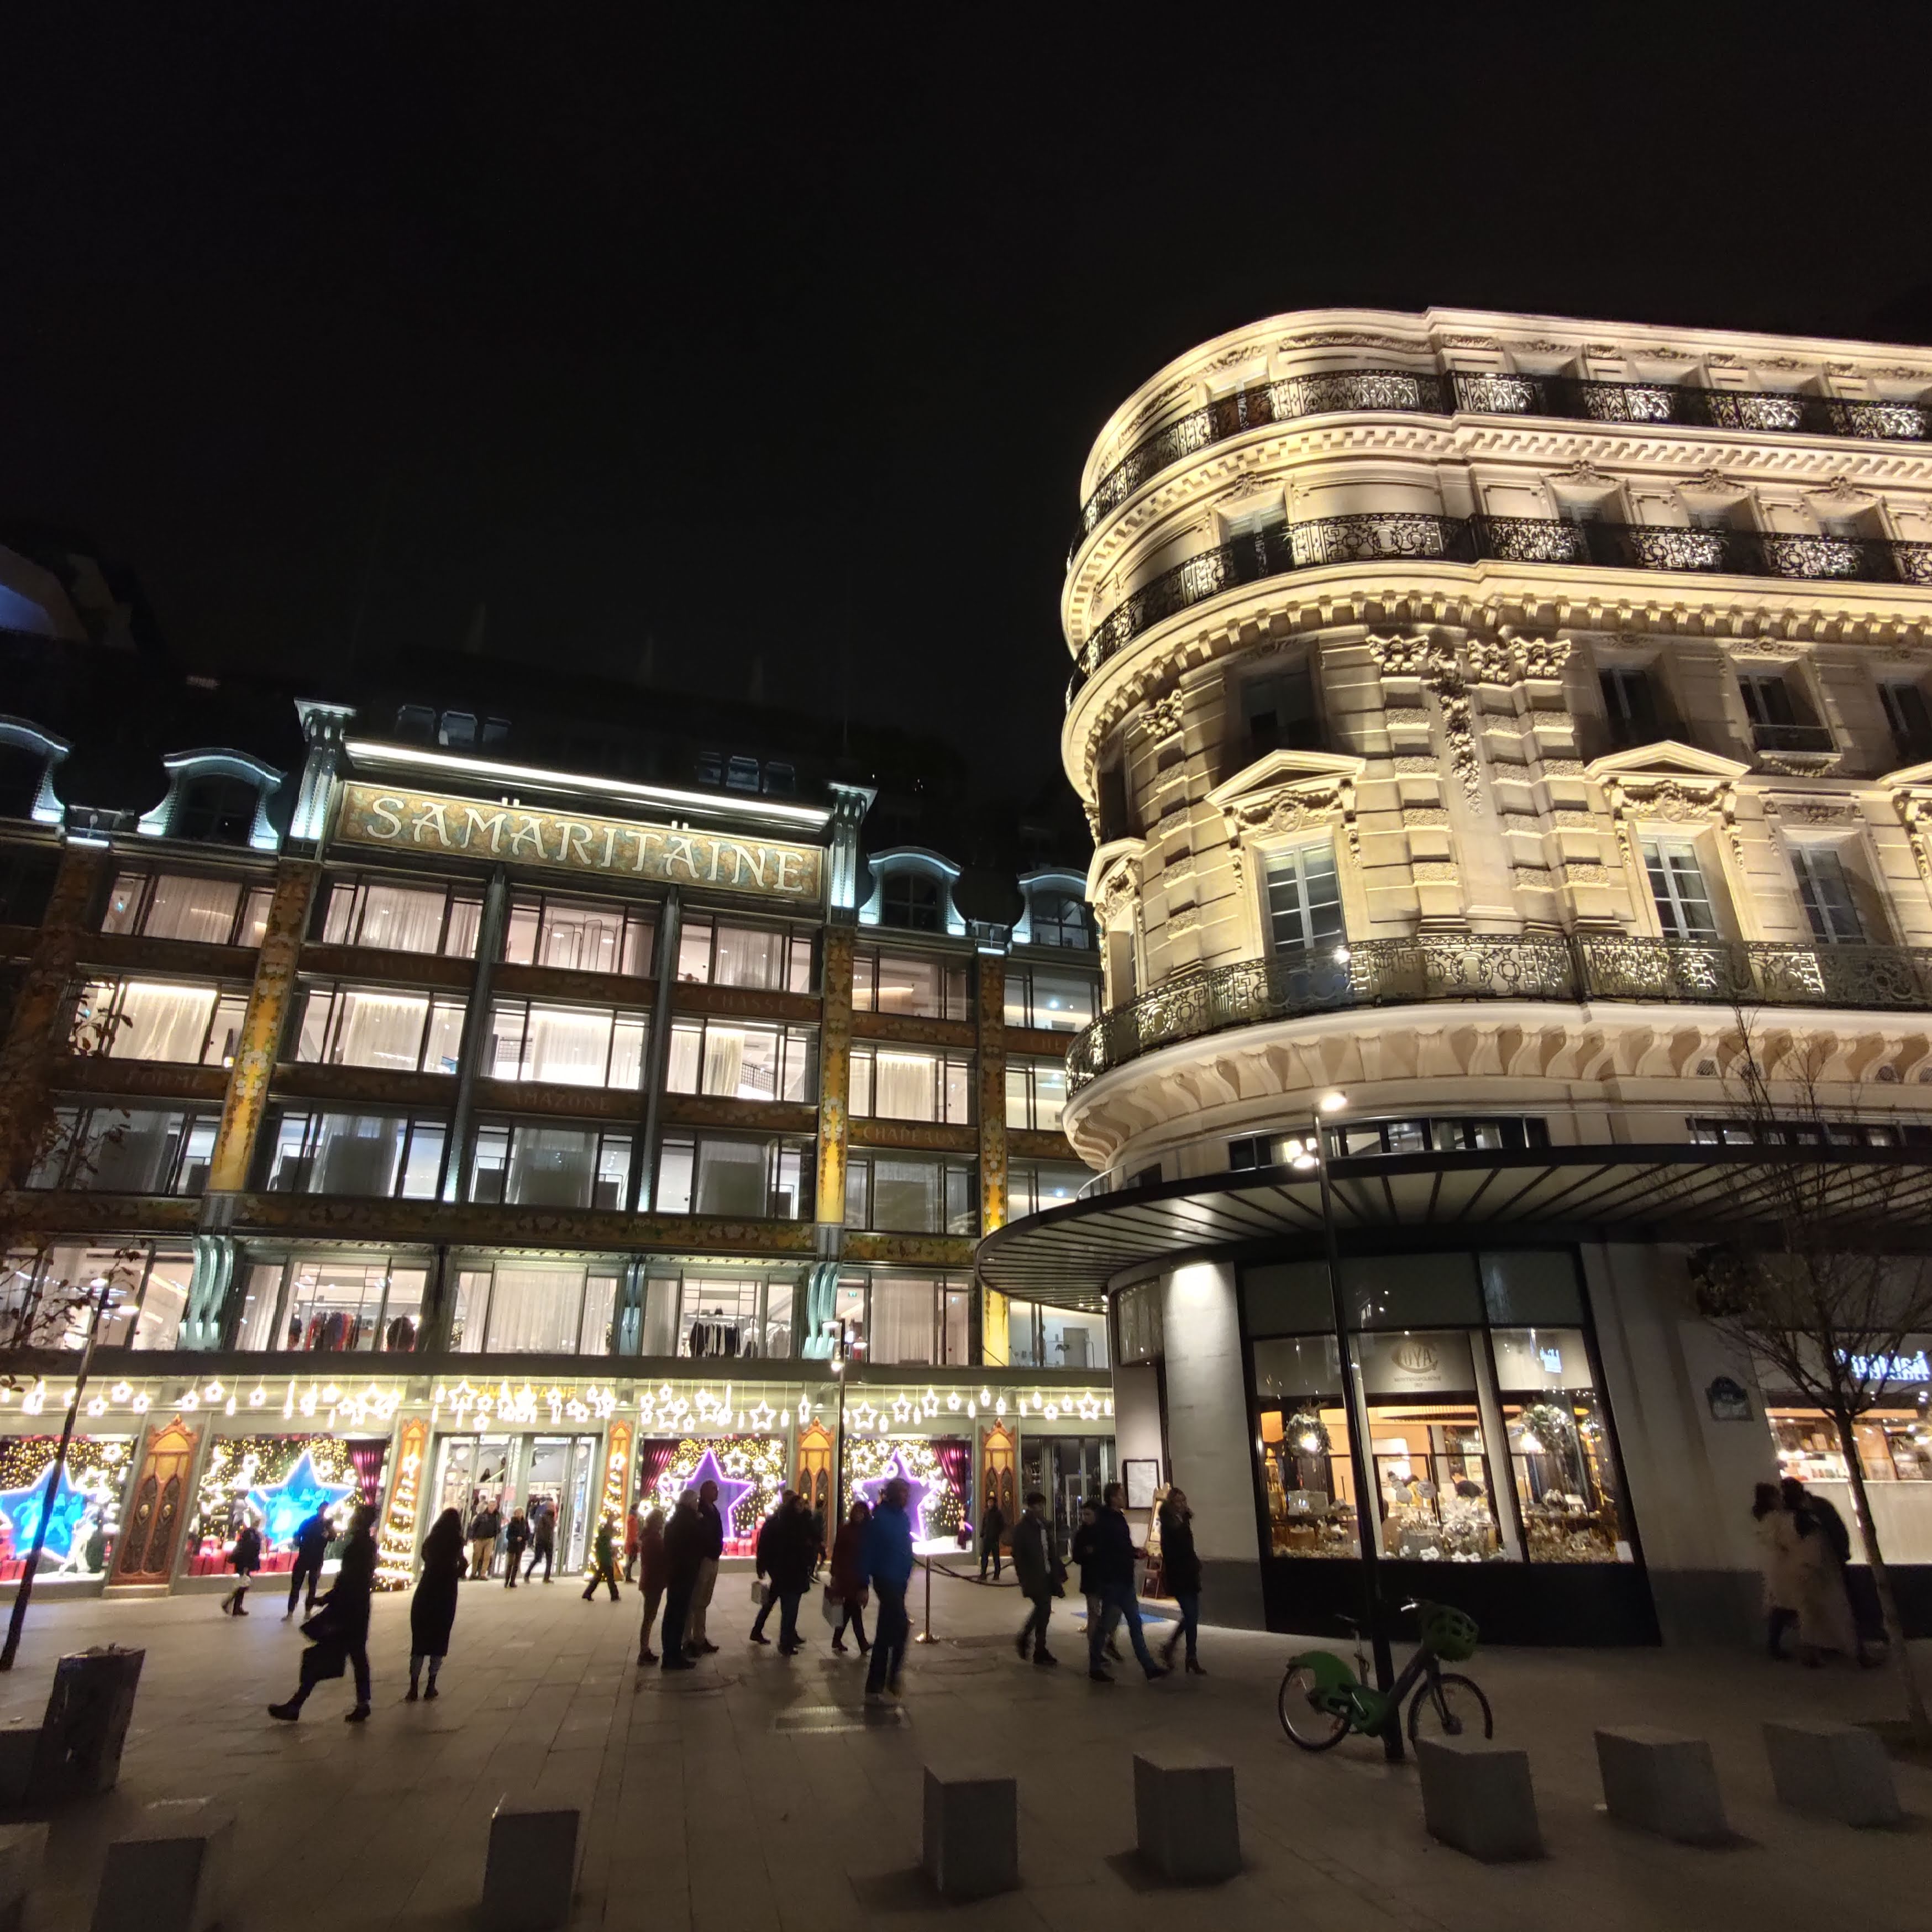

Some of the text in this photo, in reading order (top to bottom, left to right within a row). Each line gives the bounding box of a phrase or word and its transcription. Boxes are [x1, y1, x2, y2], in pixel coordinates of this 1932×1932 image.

[365, 797, 805, 893] SAMARITAINE
[513, 1091, 611, 1111] AMAZONE
[863, 1125, 957, 1146] CHAPEAUX
